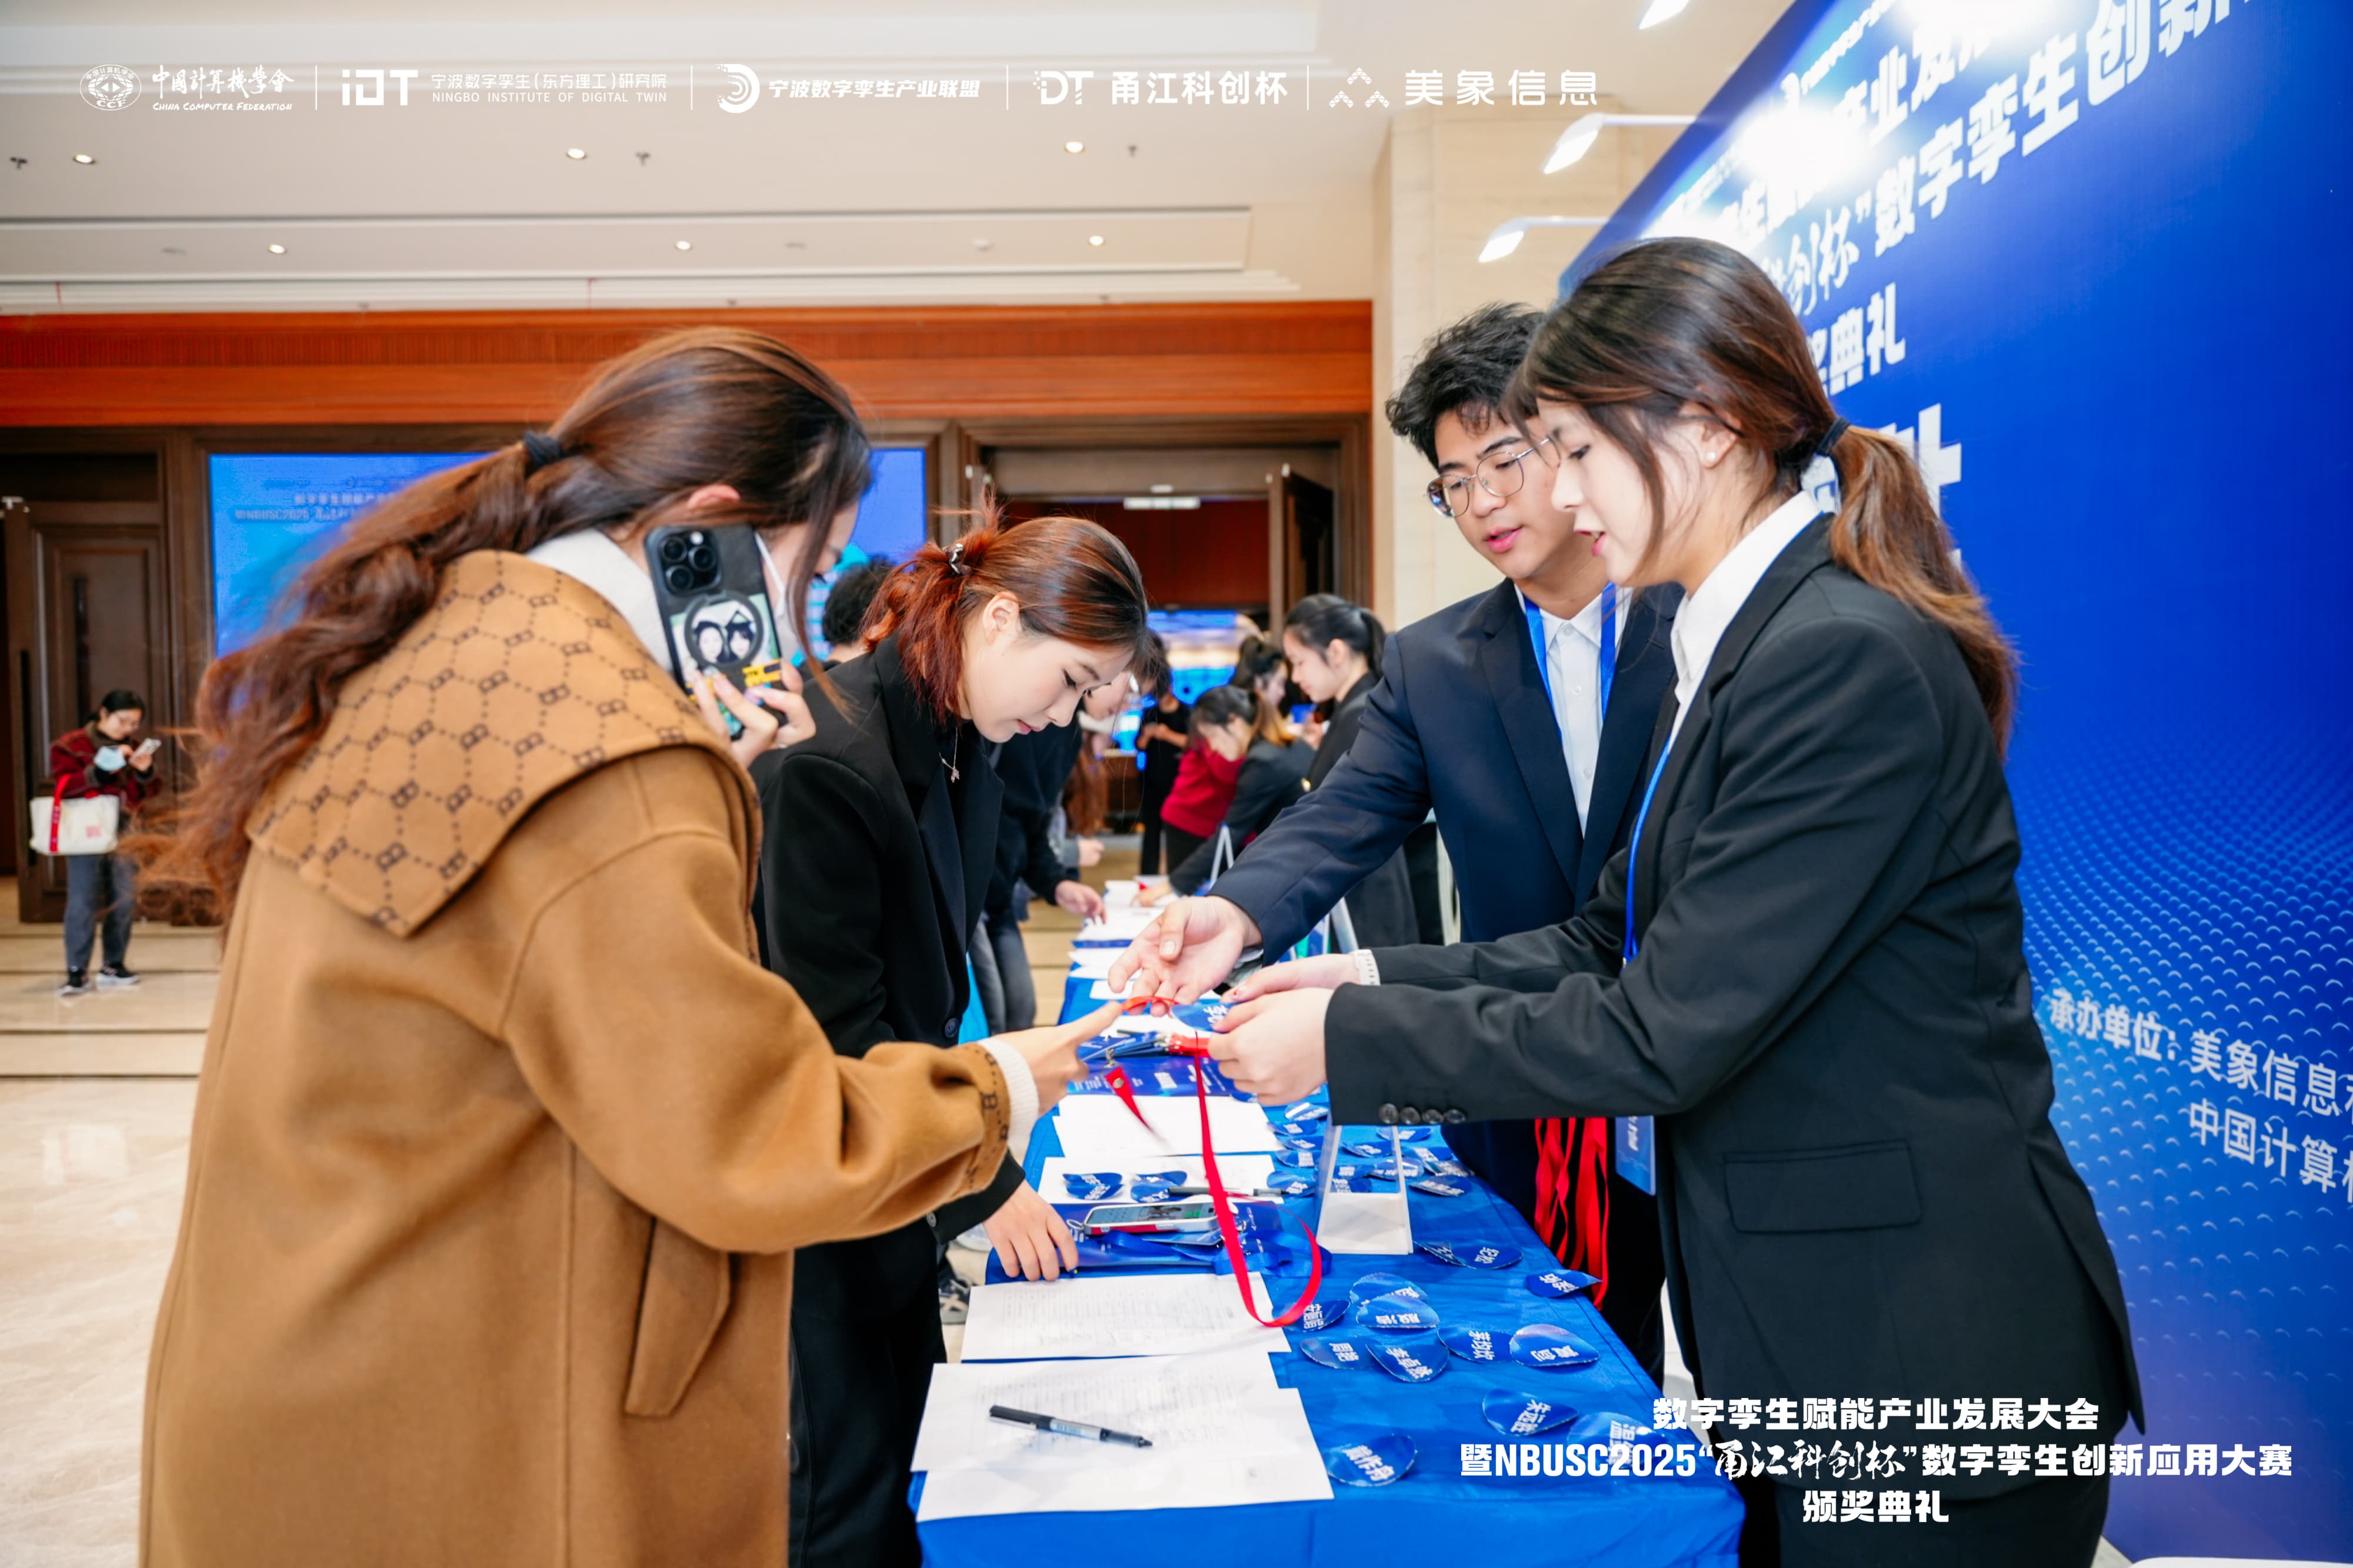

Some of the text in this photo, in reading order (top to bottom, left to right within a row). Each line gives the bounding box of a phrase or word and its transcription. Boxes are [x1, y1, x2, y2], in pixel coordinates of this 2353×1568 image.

[2049, 987, 2353, 1124] 承办单位： 美象信息
[2189, 1097, 2353, 1205] 中国计算
